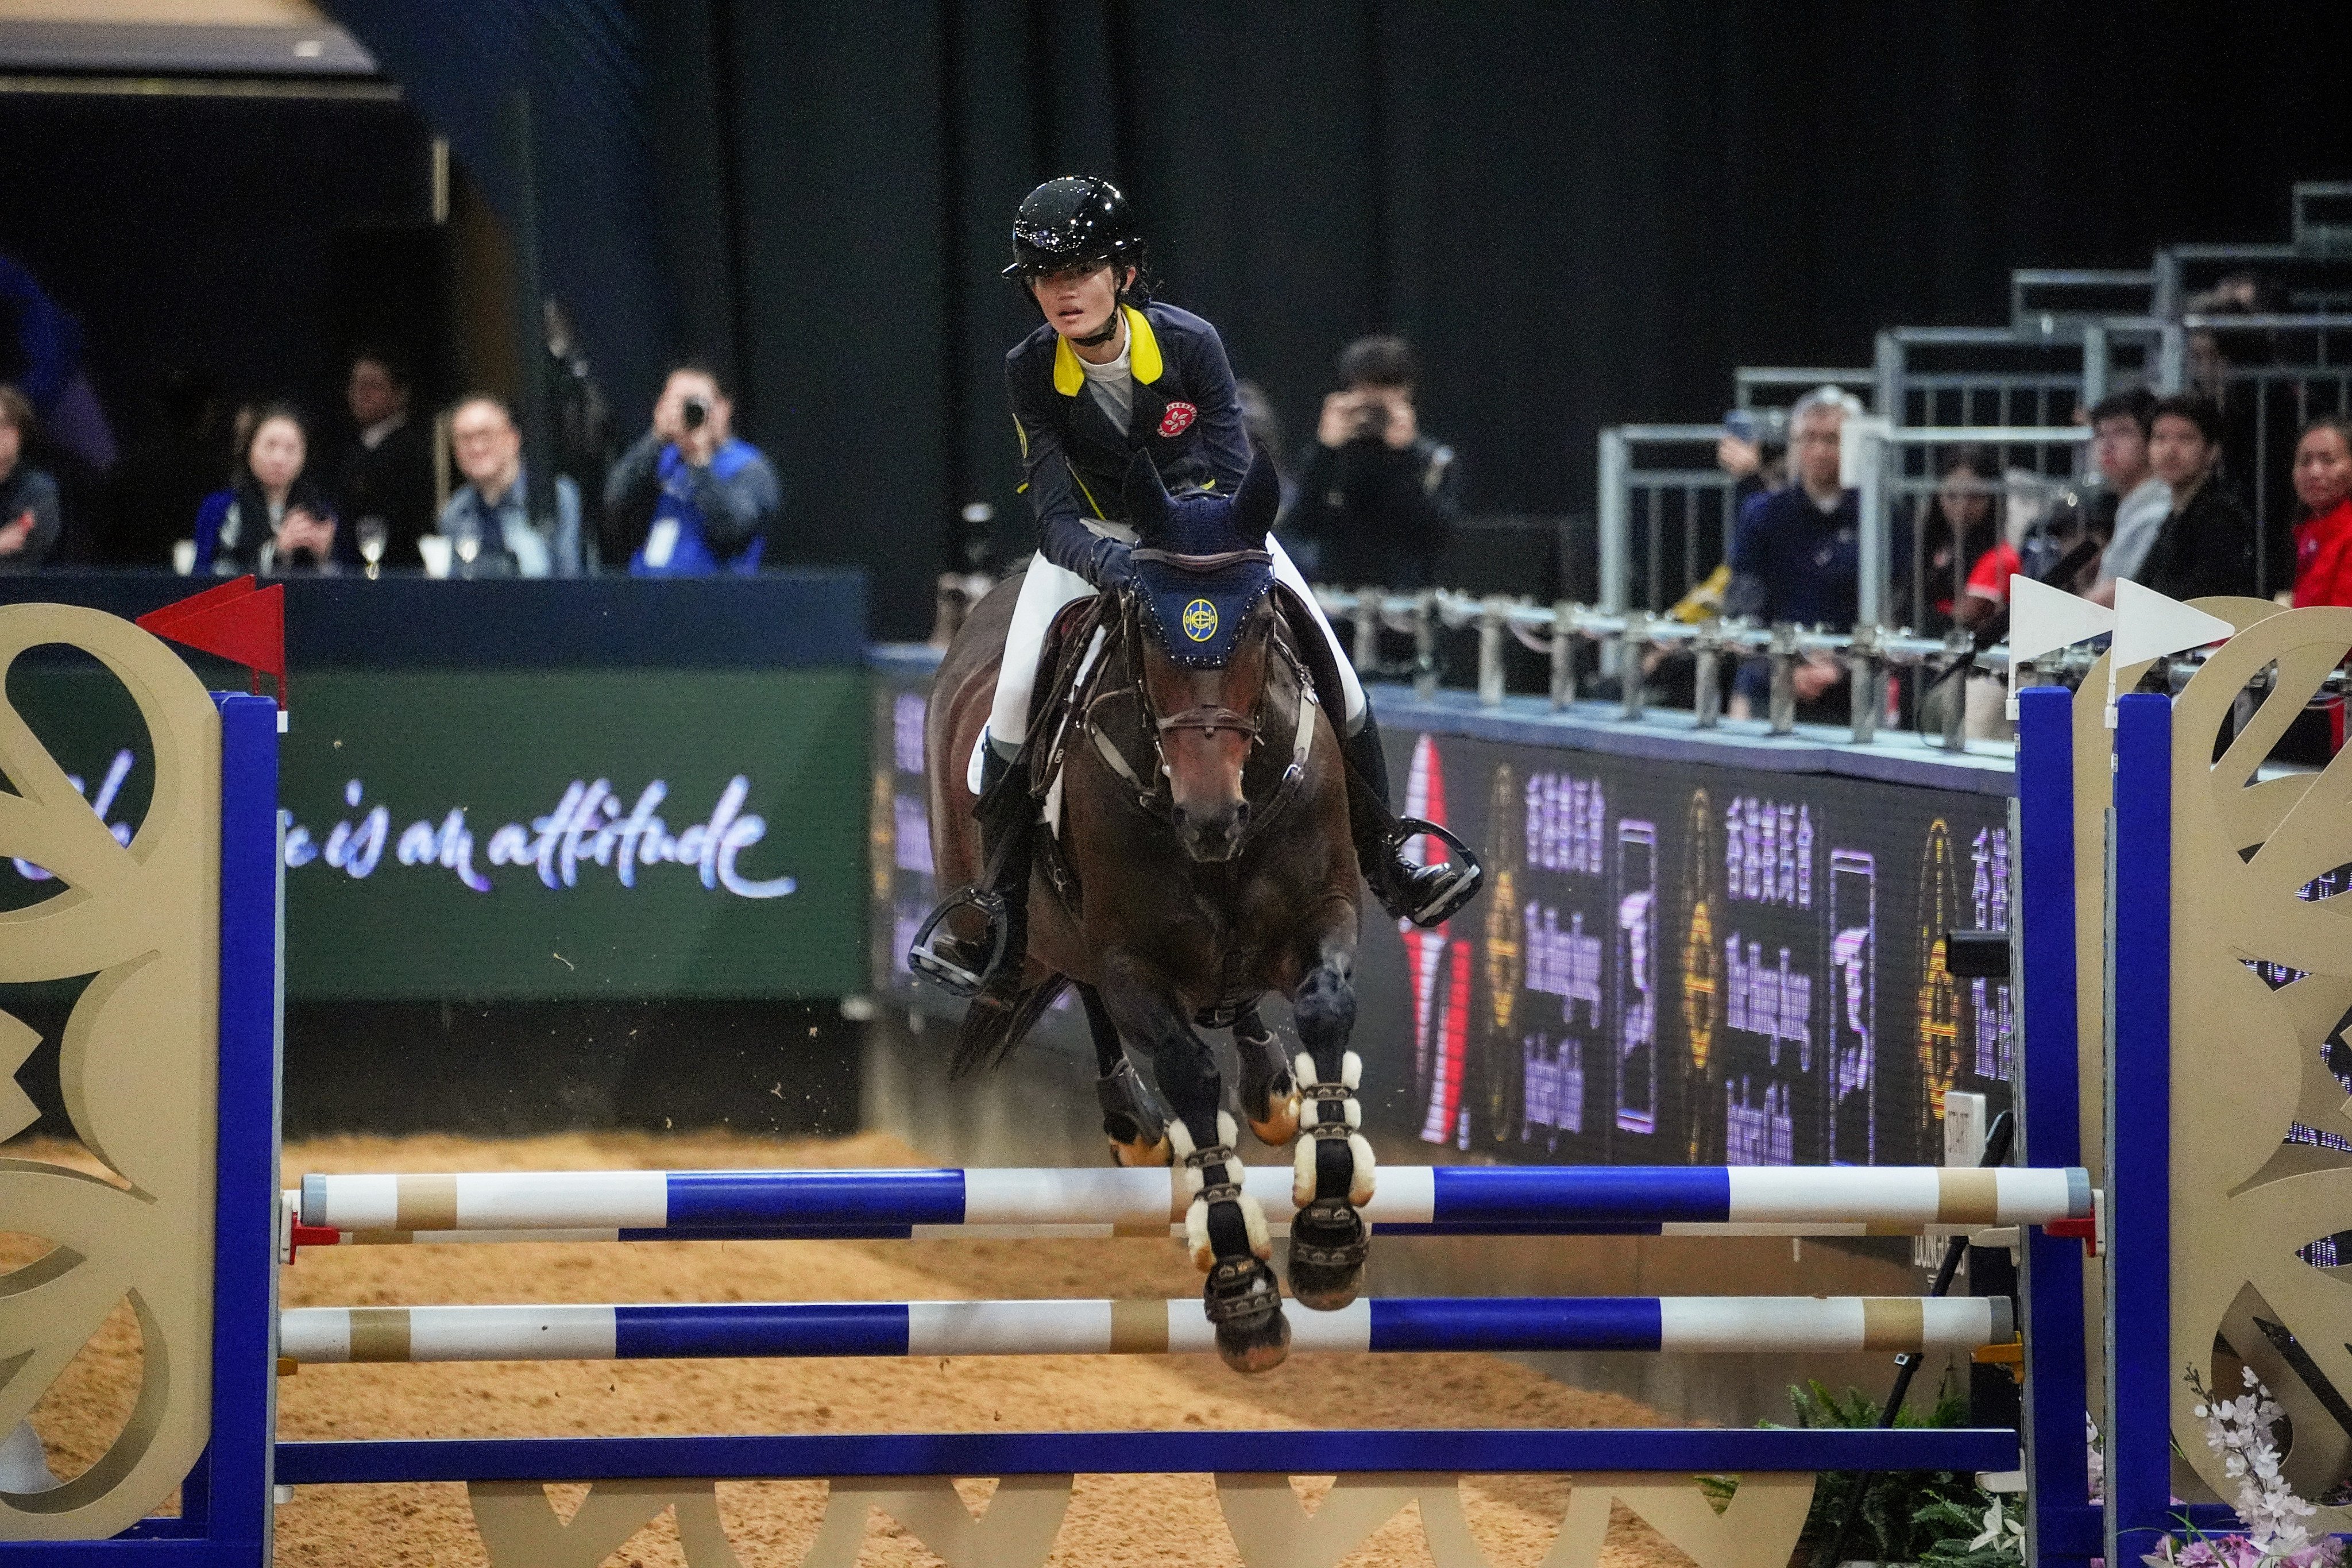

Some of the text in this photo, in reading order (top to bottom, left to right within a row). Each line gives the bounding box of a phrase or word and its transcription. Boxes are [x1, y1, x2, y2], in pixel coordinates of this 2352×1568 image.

[325, 779, 389, 879] is
[396, 806, 491, 893] an
[487, 775, 797, 898] attitude
